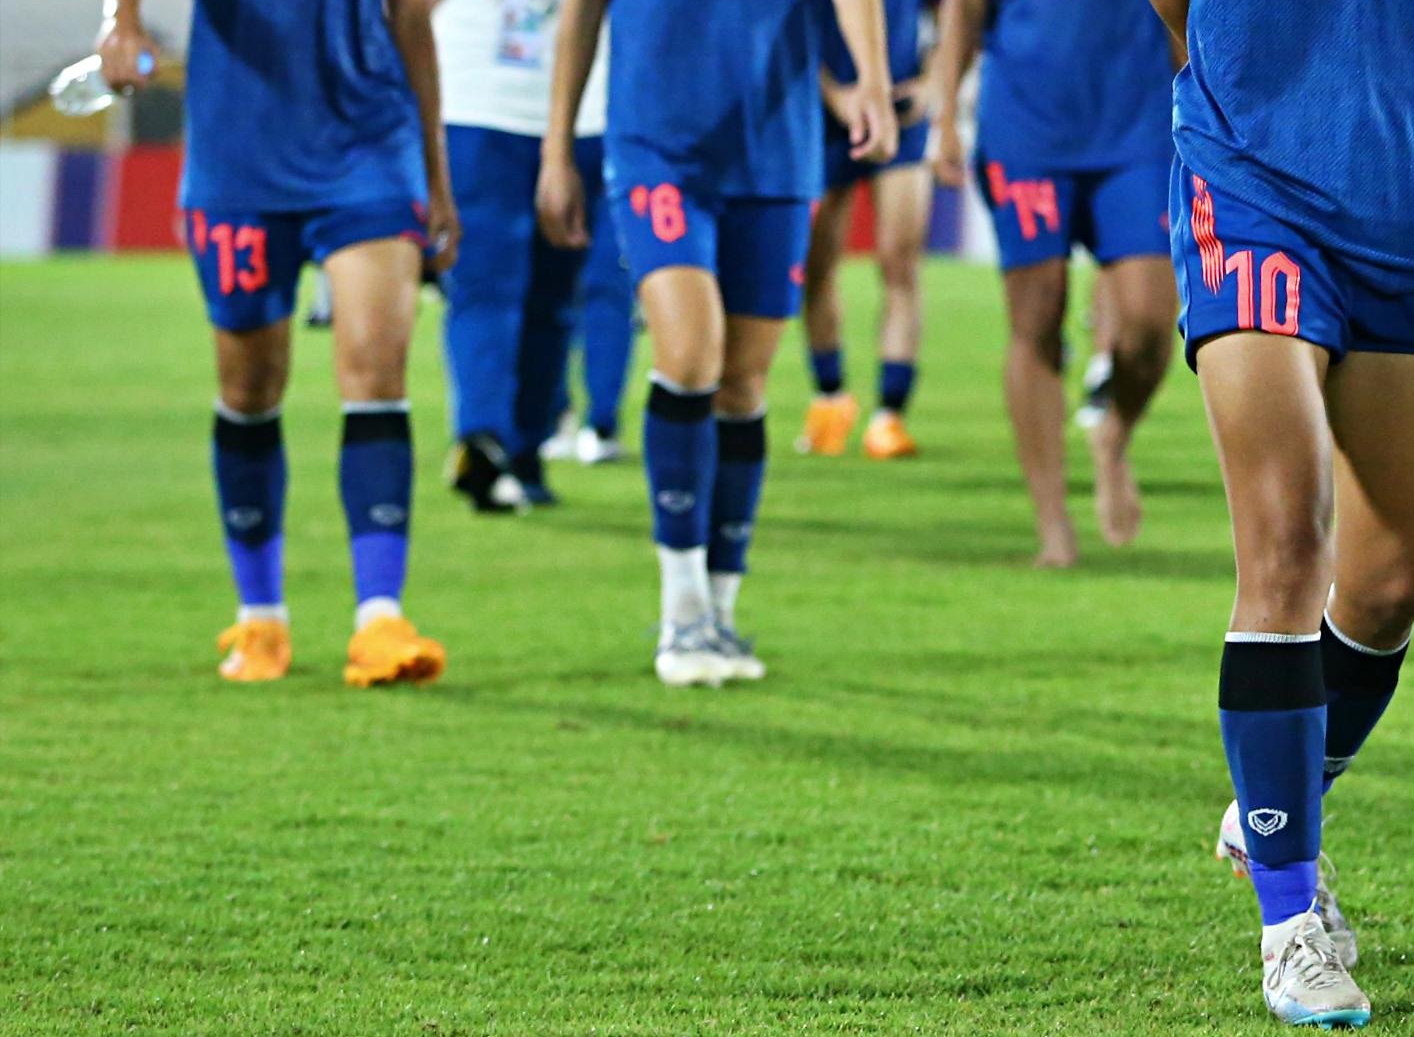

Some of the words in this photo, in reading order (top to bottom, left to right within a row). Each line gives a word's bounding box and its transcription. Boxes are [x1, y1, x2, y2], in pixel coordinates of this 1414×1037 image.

[650, 182, 687, 243] 6
[1006, 179, 1061, 241] 14
[210, 222, 270, 295] 13
[1225, 250, 1301, 337] 10
